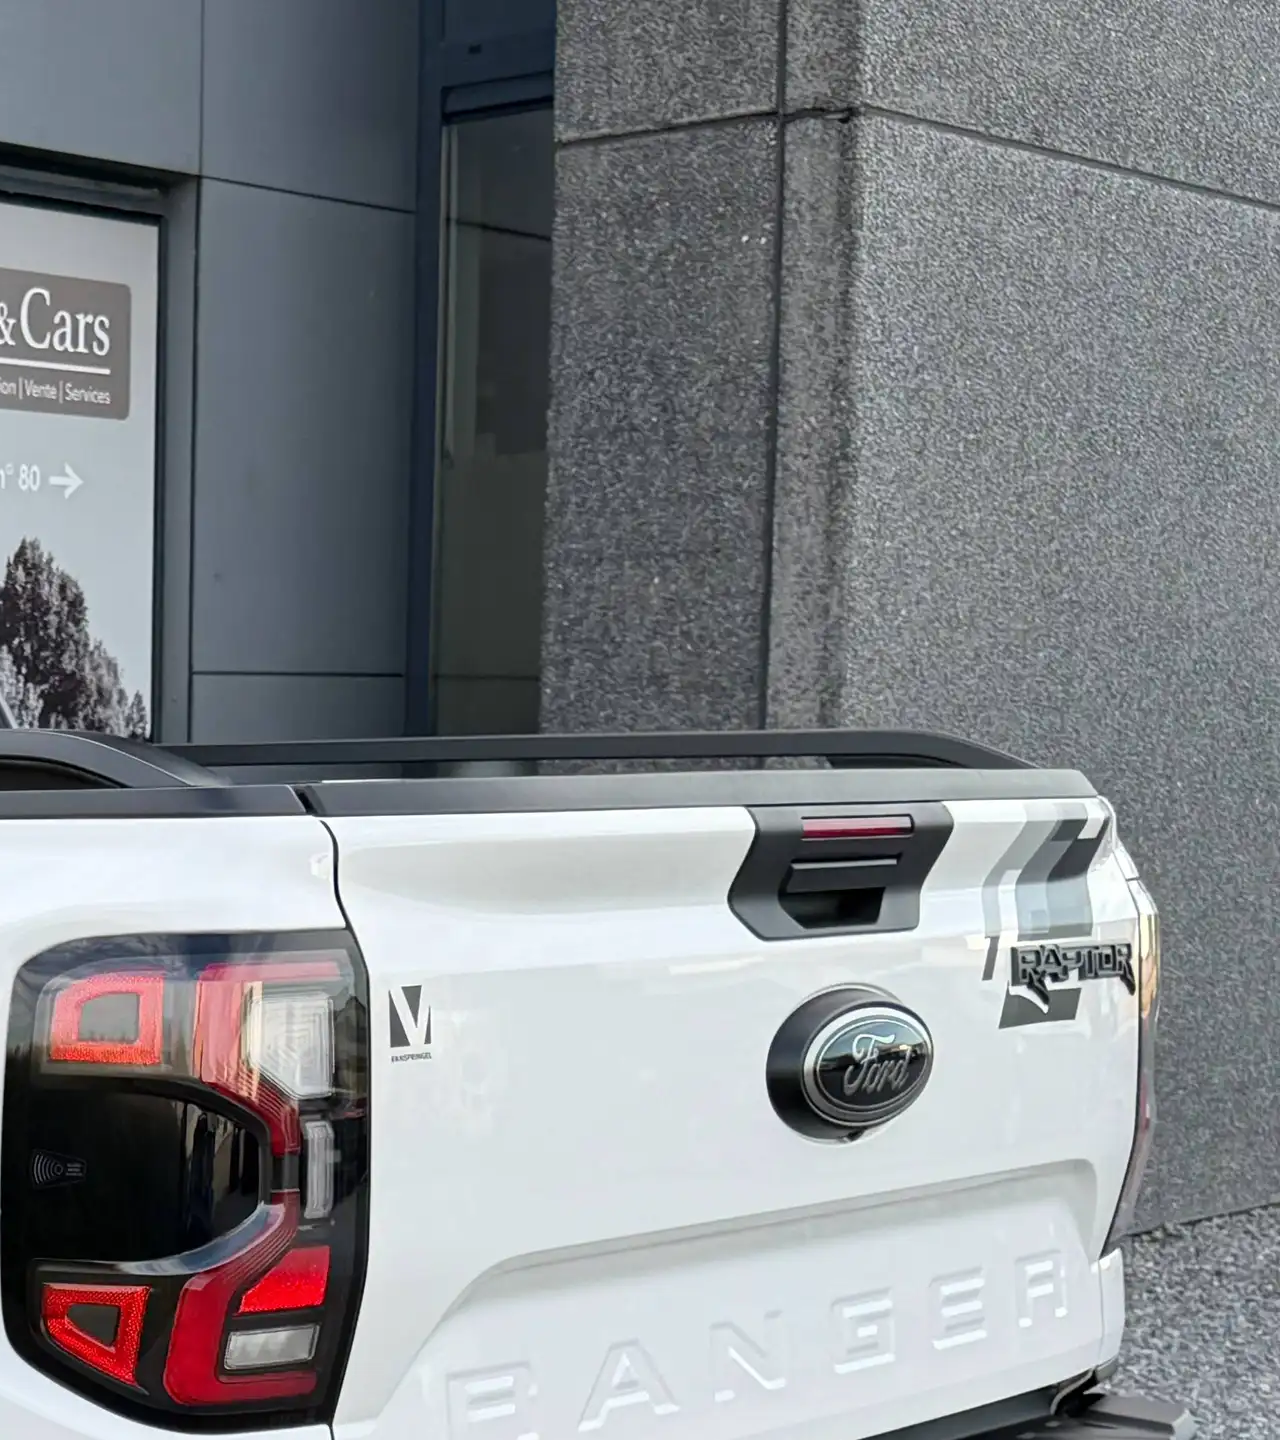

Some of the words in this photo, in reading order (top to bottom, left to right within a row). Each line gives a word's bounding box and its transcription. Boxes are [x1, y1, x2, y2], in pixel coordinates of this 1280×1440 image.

[25, 378, 58, 399] Vente
[65, 382, 111, 405] Services
[18, 463, 40, 491] 80
[1011, 943, 1136, 1013] RAPTOR
[843, 1033, 911, 1096] Ford
